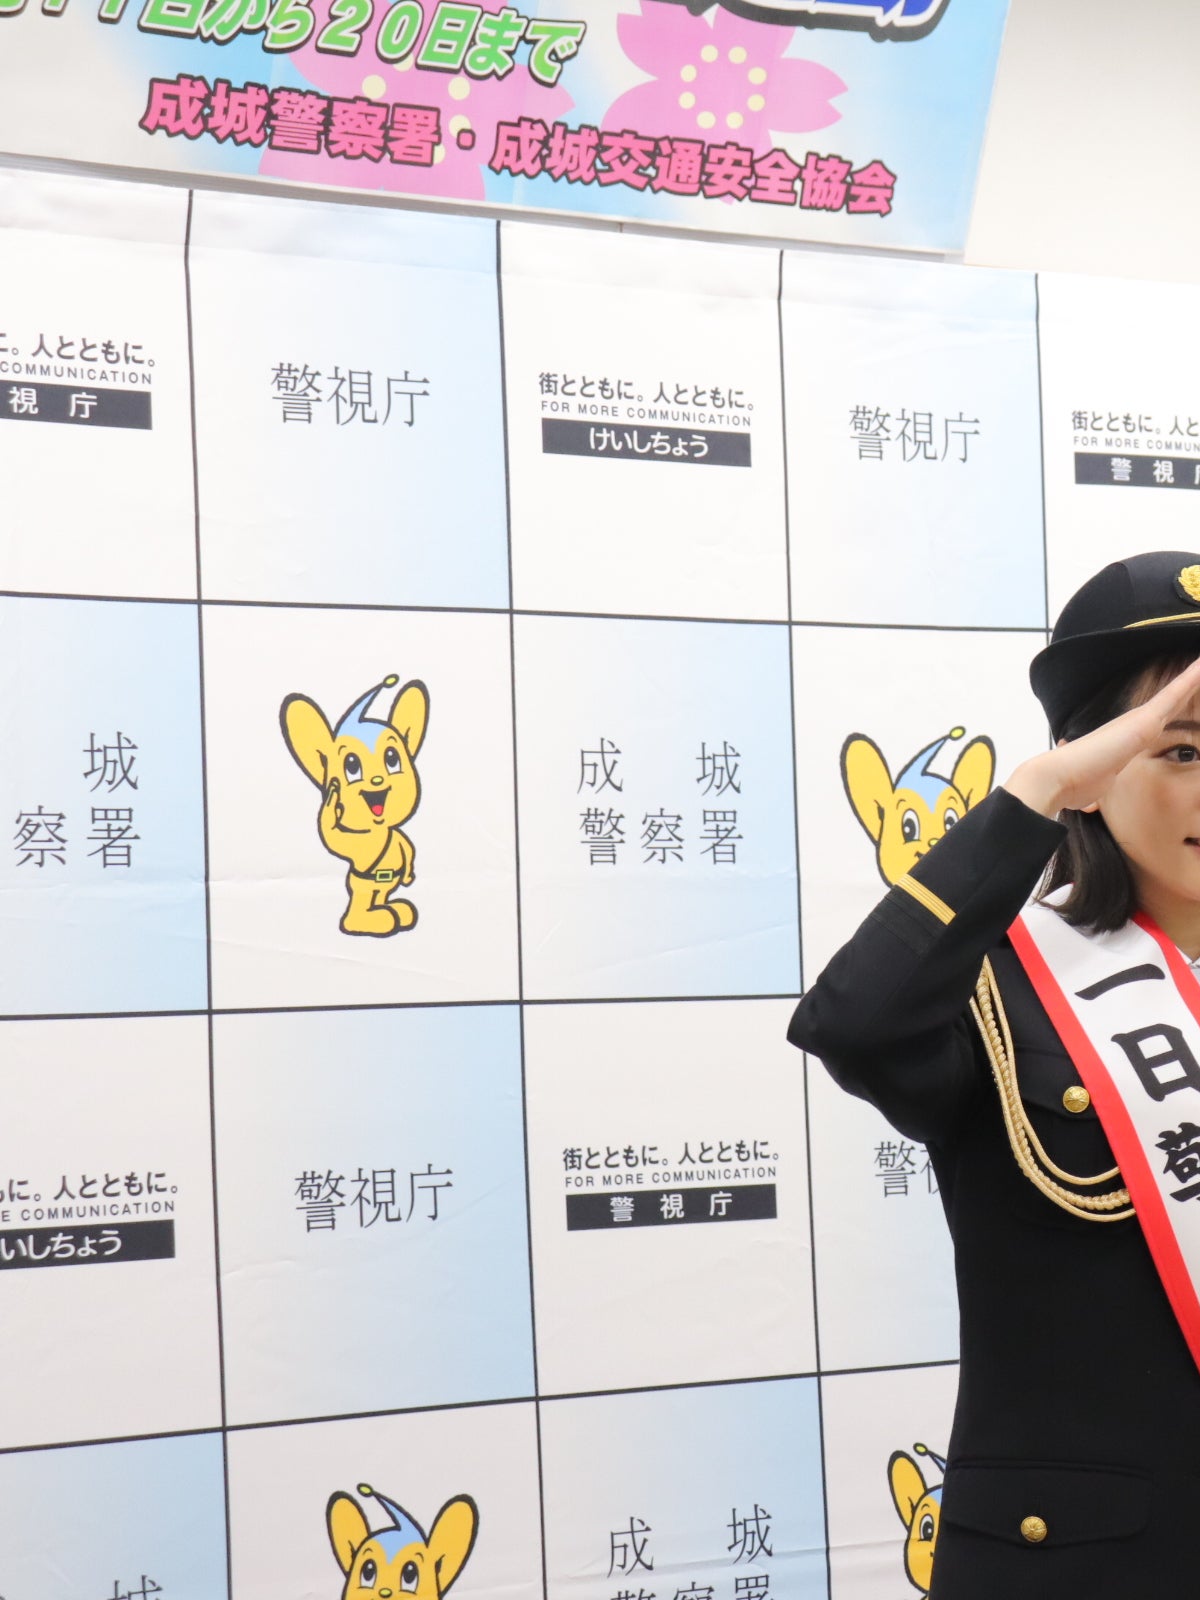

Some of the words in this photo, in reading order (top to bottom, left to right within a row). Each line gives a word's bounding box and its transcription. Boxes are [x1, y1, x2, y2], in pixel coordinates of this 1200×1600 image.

[139, 73, 897, 217] 成城警察署・成城交通安全協会
[0, 361, 152, 384] COMMUNICATION
[9, 386, 98, 419] 視庁
[271, 362, 430, 427] 警視庁
[541, 400, 570, 413] FOR
[578, 404, 619, 417] MORE
[627, 408, 751, 426] COMMUNICATION
[589, 427, 709, 457] けいしちょう
[849, 405, 980, 463] 警視庁
[1073, 436, 1098, 446] FOR
[1105, 438, 1140, 449] MORE
[83, 731, 139, 793] 城
[13, 805, 141, 868] 察署
[579, 807, 744, 866] 警察署
[565, 1175, 595, 1188] FOR
[602, 1173, 644, 1186] MORE
[652, 1166, 777, 1183] COMMUNICATION
[874, 1139, 941, 1198] 警
[0, 1171, 178, 1203] に。人とともに。
[294, 1163, 453, 1233] 警視庁
[1, 1210, 10, 1222] E
[21, 1201, 175, 1221] COMMUNICATION
[610, 1190, 732, 1222] 警視庁
[0, 1230, 122, 1261] いしちょう
